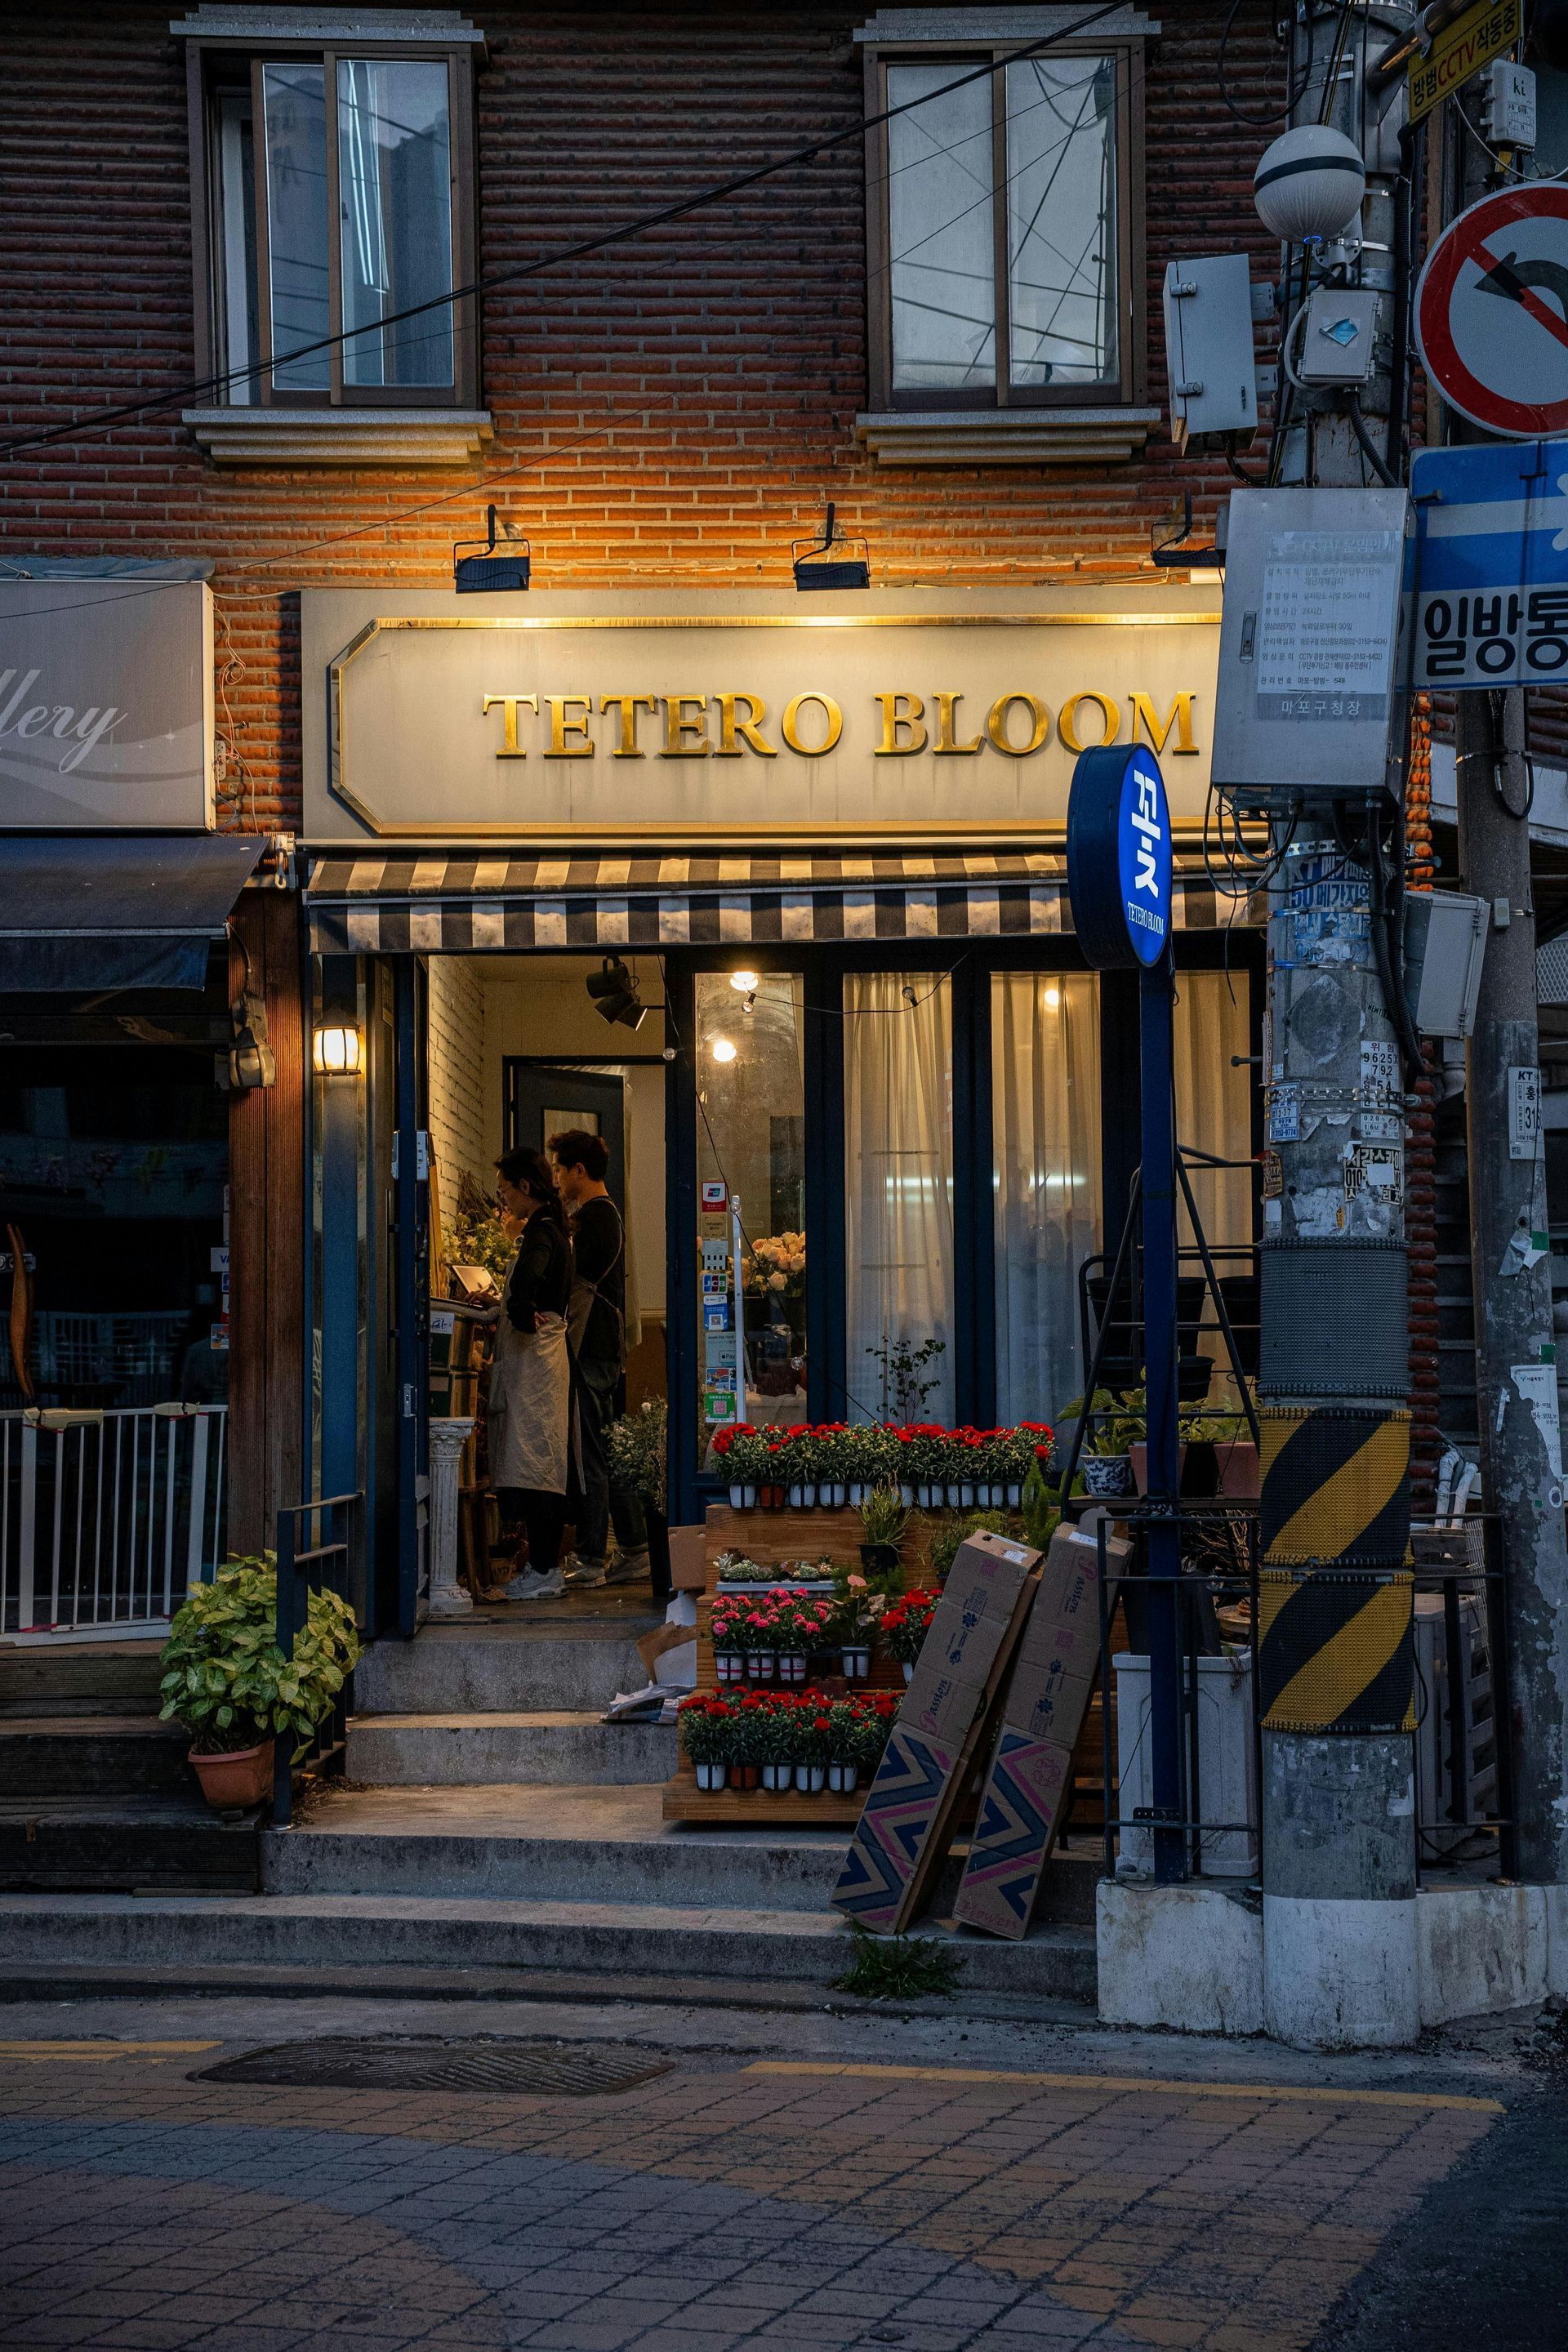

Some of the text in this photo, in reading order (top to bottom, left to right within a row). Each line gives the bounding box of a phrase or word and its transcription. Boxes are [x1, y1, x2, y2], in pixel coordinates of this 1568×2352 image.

[1281, 700, 1361, 715] 마포구청장
[482, 690, 1200, 757] TETERO BLOOM
[1127, 901, 1165, 937] TETERO BLOOM
[1372, 1065, 1392, 1076] 792
[1518, 1071, 1533, 1080] KT
